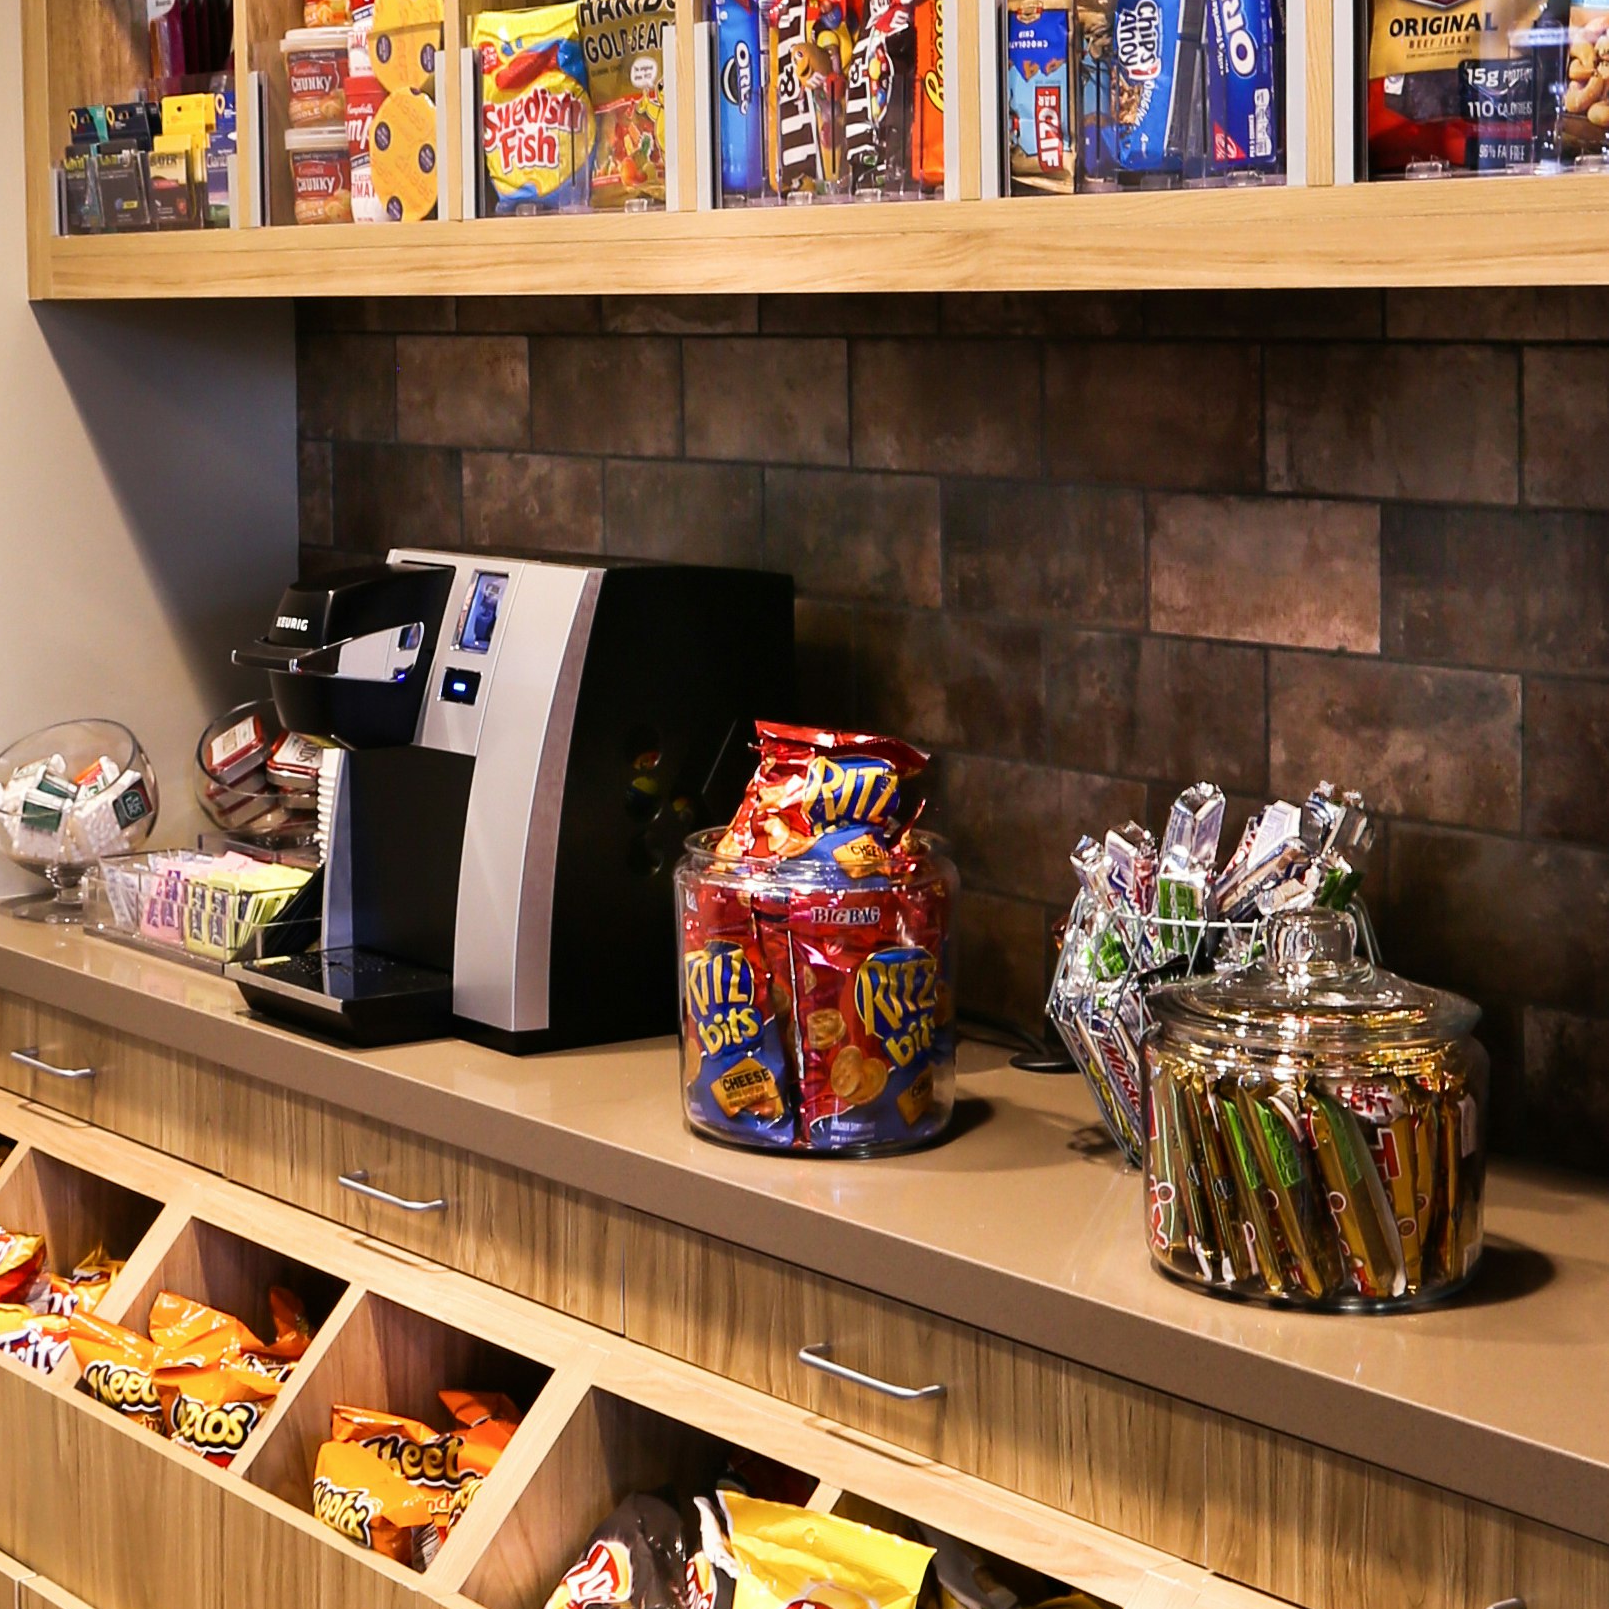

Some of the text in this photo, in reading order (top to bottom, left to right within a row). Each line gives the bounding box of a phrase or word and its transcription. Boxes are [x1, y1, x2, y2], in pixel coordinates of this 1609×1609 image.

[1135, 0, 1158, 65] Chips
[1388, 12, 1499, 38] ORIGINAL
[1009, 40, 1049, 49] CHOCOLAT
[1466, 67, 1500, 88] 15g
[483, 89, 584, 149] Swedish
[1467, 100, 1494, 119] 110
[499, 126, 558, 171] Fish
[1038, 107, 1061, 169] CLIF
[276, 616, 309, 632] KEURIG
[801, 755, 899, 823] RITZ
[811, 905, 881, 925] BIG BAG
[859, 958, 937, 1036] RITZ
[698, 1007, 760, 1056] bits
[722, 1068, 772, 1092] CHEESE
